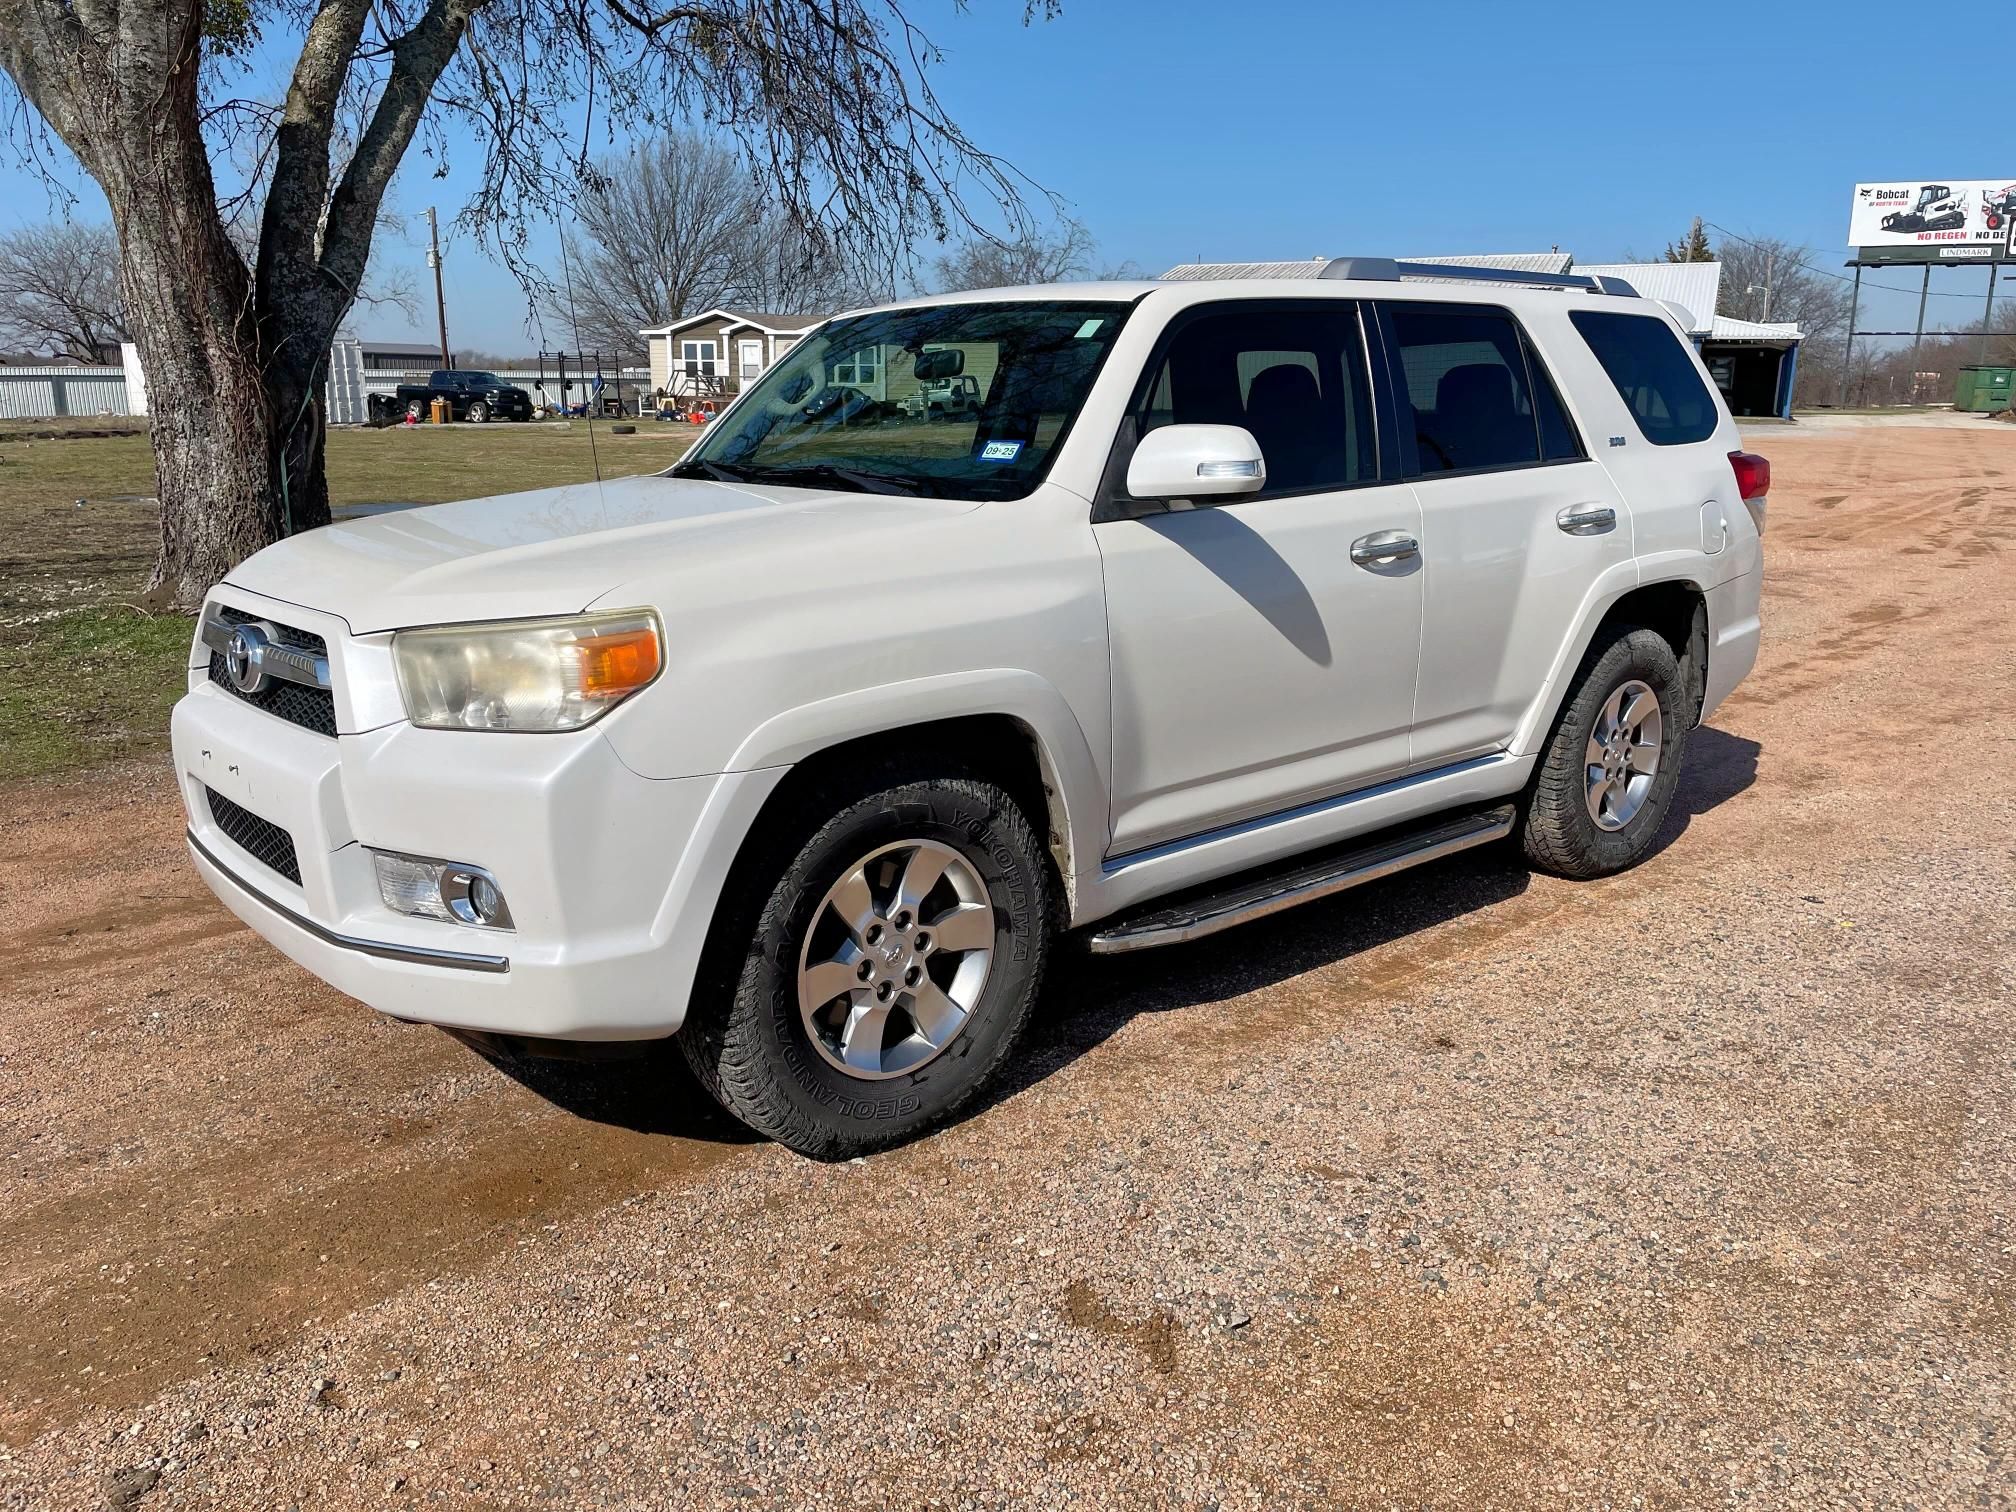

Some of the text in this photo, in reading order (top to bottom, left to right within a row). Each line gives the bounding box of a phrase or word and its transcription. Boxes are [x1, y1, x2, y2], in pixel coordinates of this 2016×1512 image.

[1876, 189, 1909, 199] Bobcat
[1917, 232, 1932, 241] NO
[1934, 231, 1967, 240] REGEN
[1975, 231, 1990, 240] NO
[951, 807, 1030, 962] YOKOHAMA
